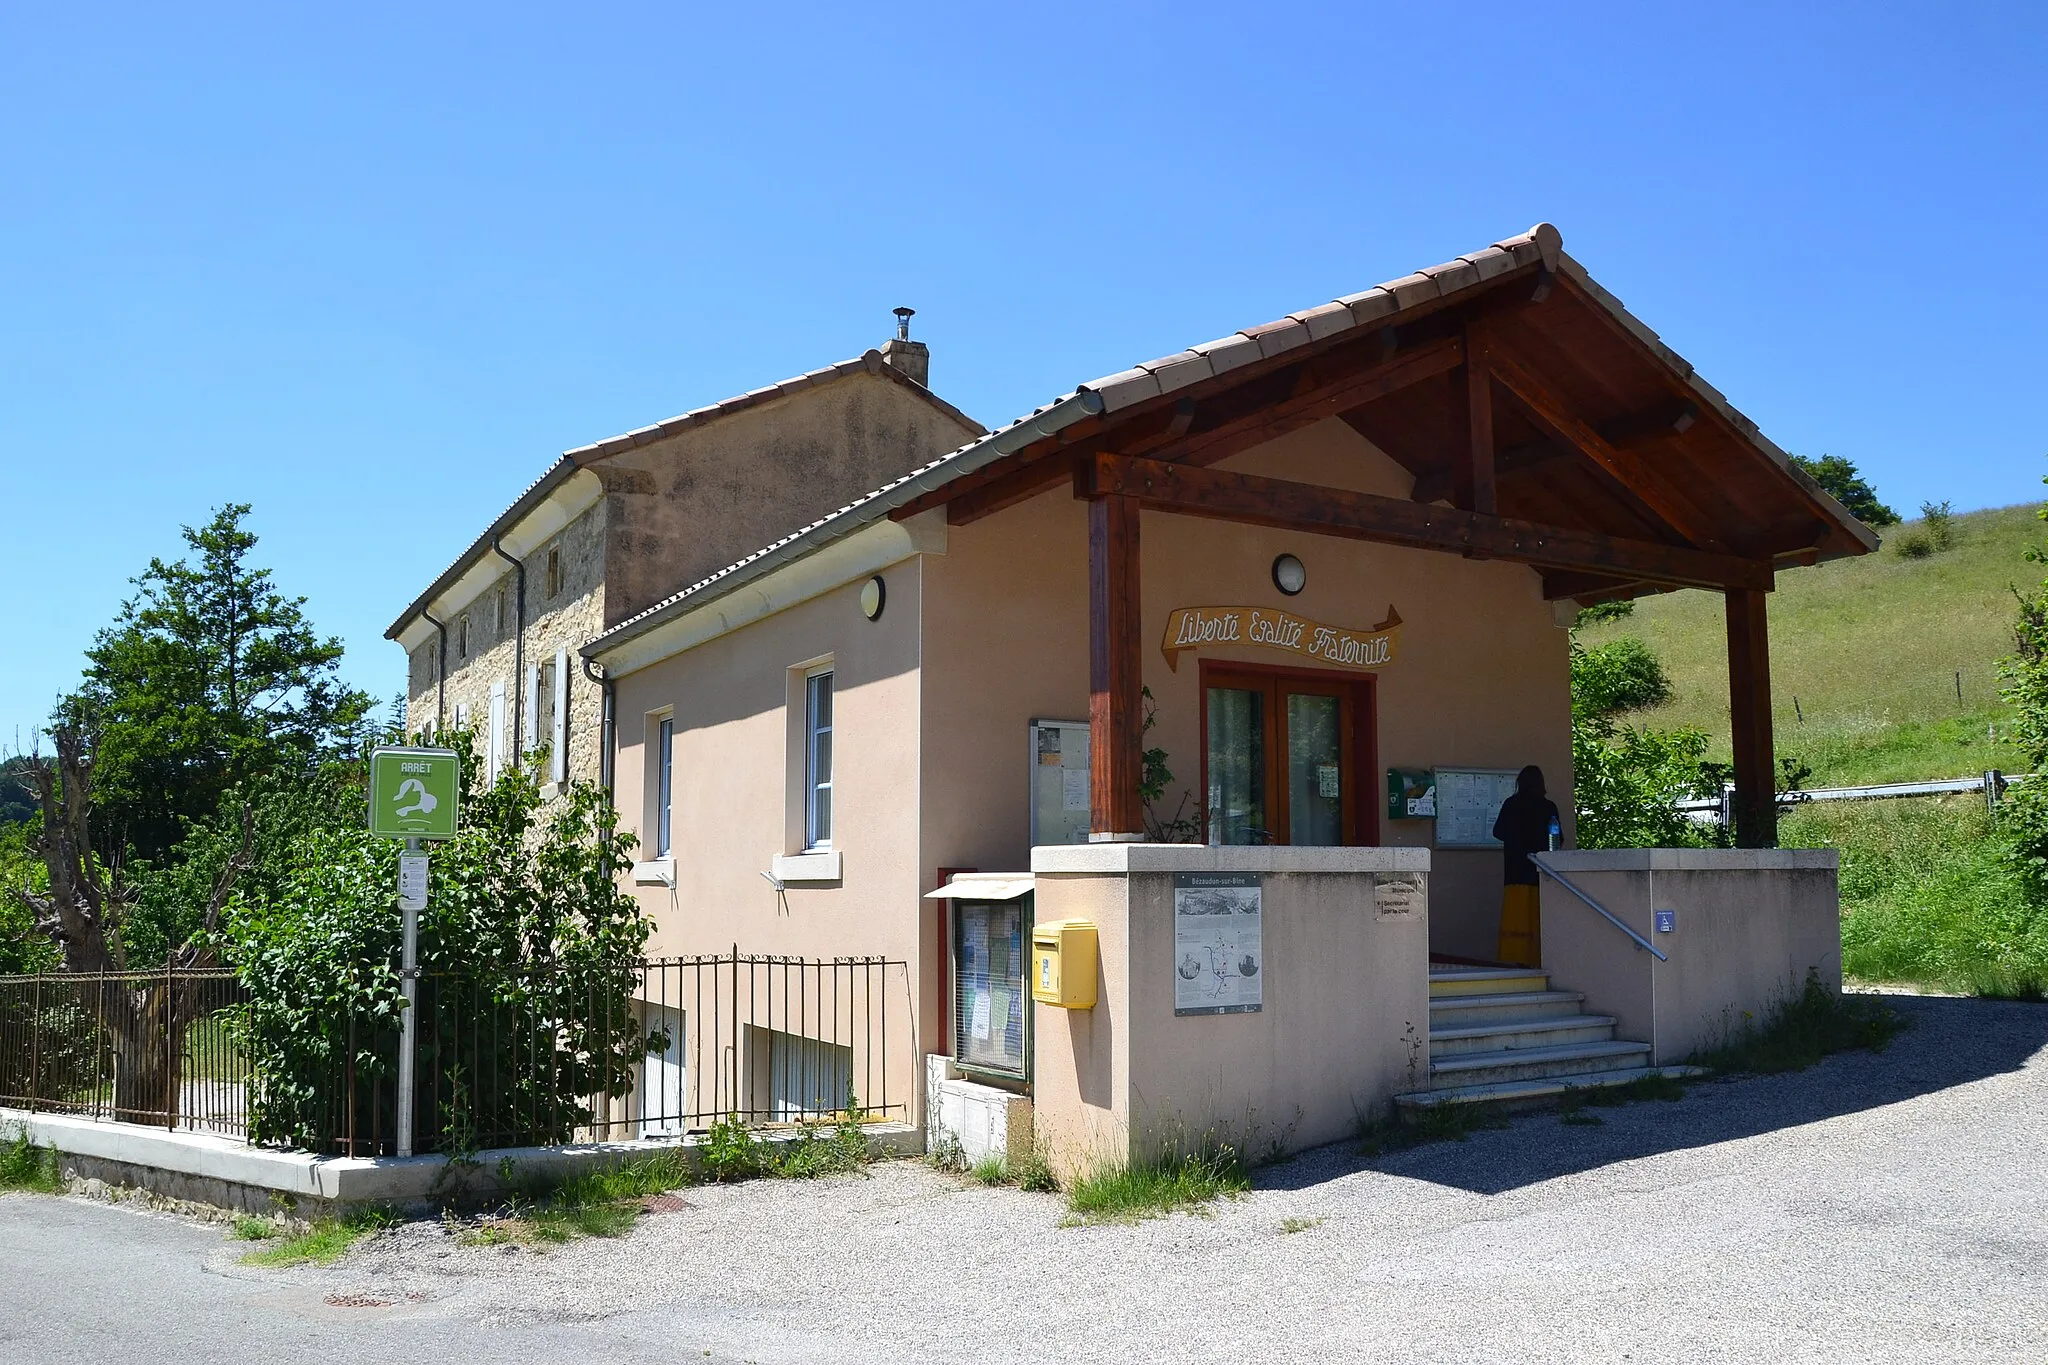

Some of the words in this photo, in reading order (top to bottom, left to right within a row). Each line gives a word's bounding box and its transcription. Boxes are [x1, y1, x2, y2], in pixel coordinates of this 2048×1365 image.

[1175, 612, 1240, 645] Liberté
[1249, 611, 1305, 648] Egalité
[1308, 627, 1392, 664] Fraternité
[401, 760, 432, 773] ARRÊT
